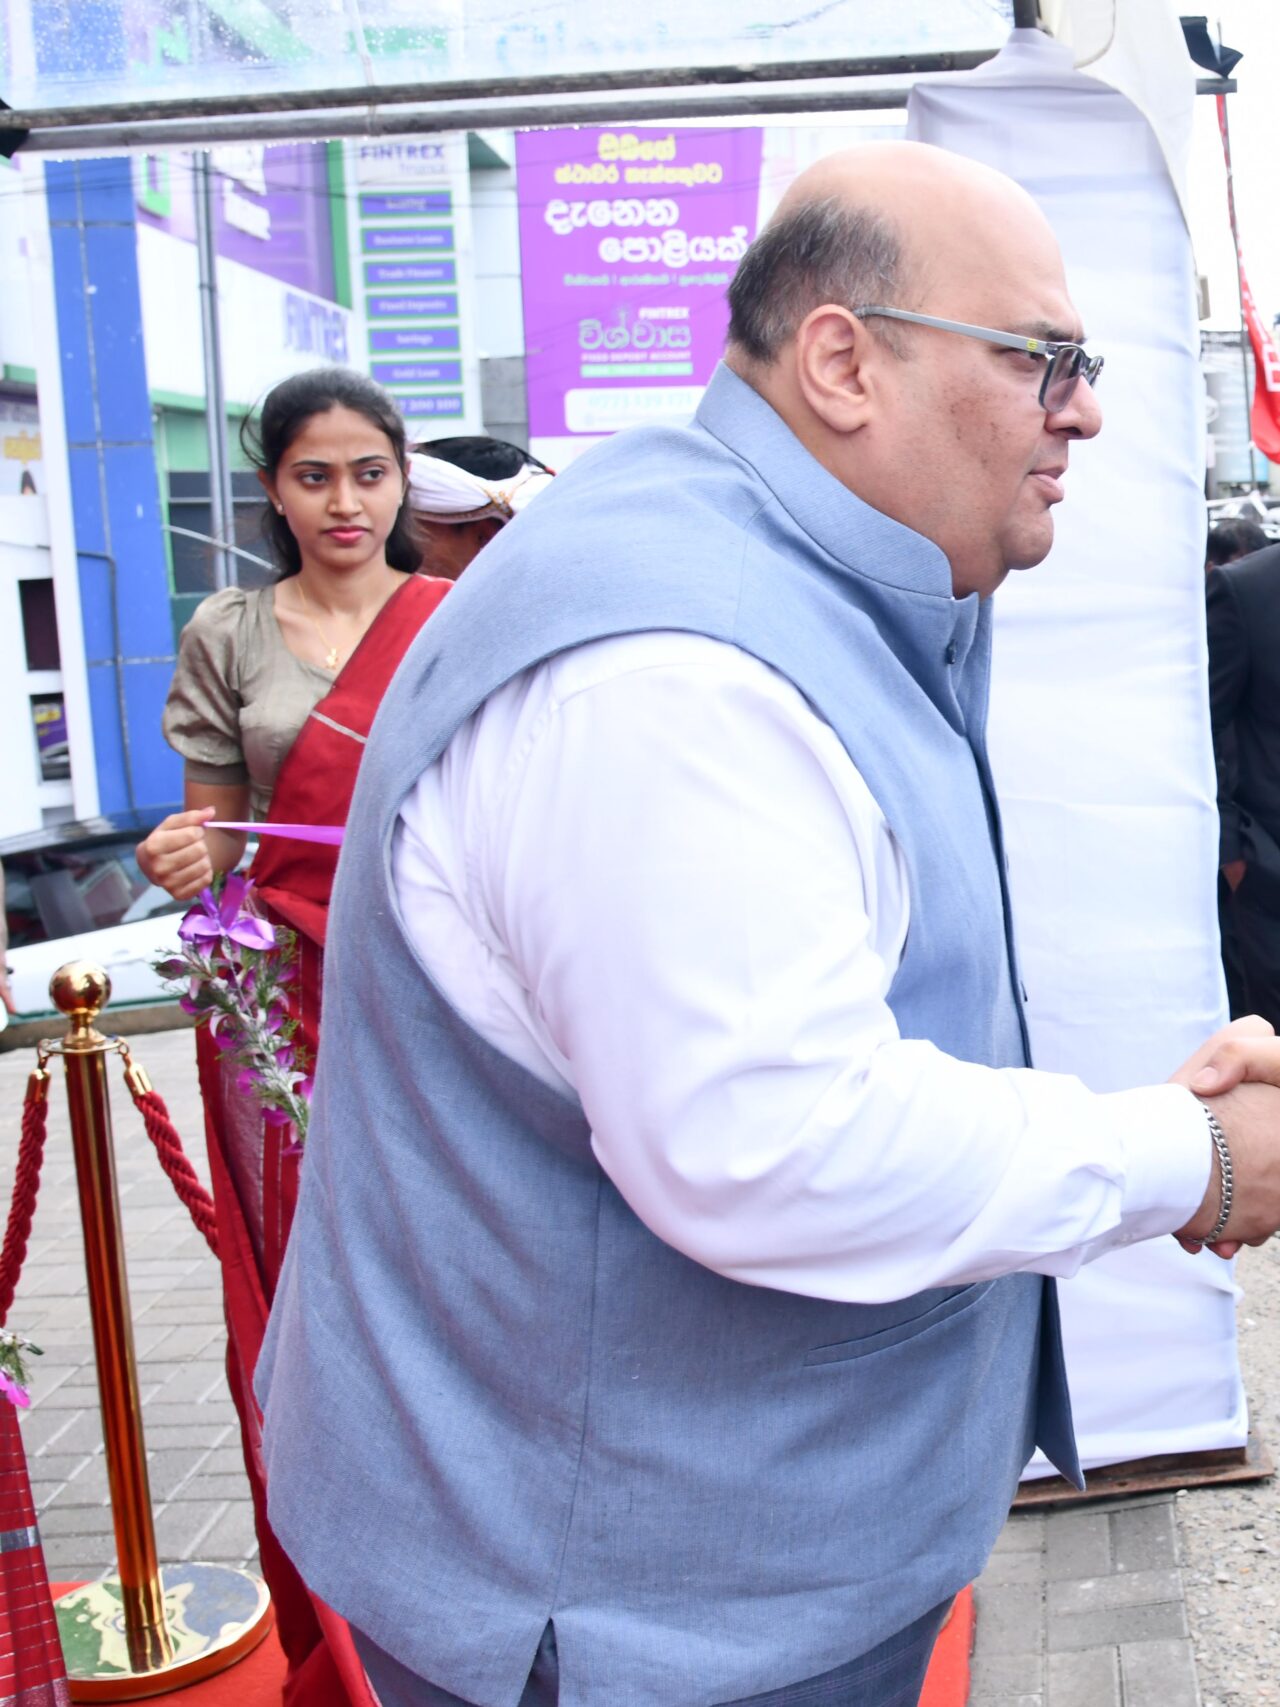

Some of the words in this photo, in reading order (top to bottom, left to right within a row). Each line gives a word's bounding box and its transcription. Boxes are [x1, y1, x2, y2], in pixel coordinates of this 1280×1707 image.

[360, 145, 444, 159] FINTREX
[544, 199, 680, 235] දැනෙන
[599, 226, 749, 268] පොළියක්
[638, 306, 690, 319] FINTREX
